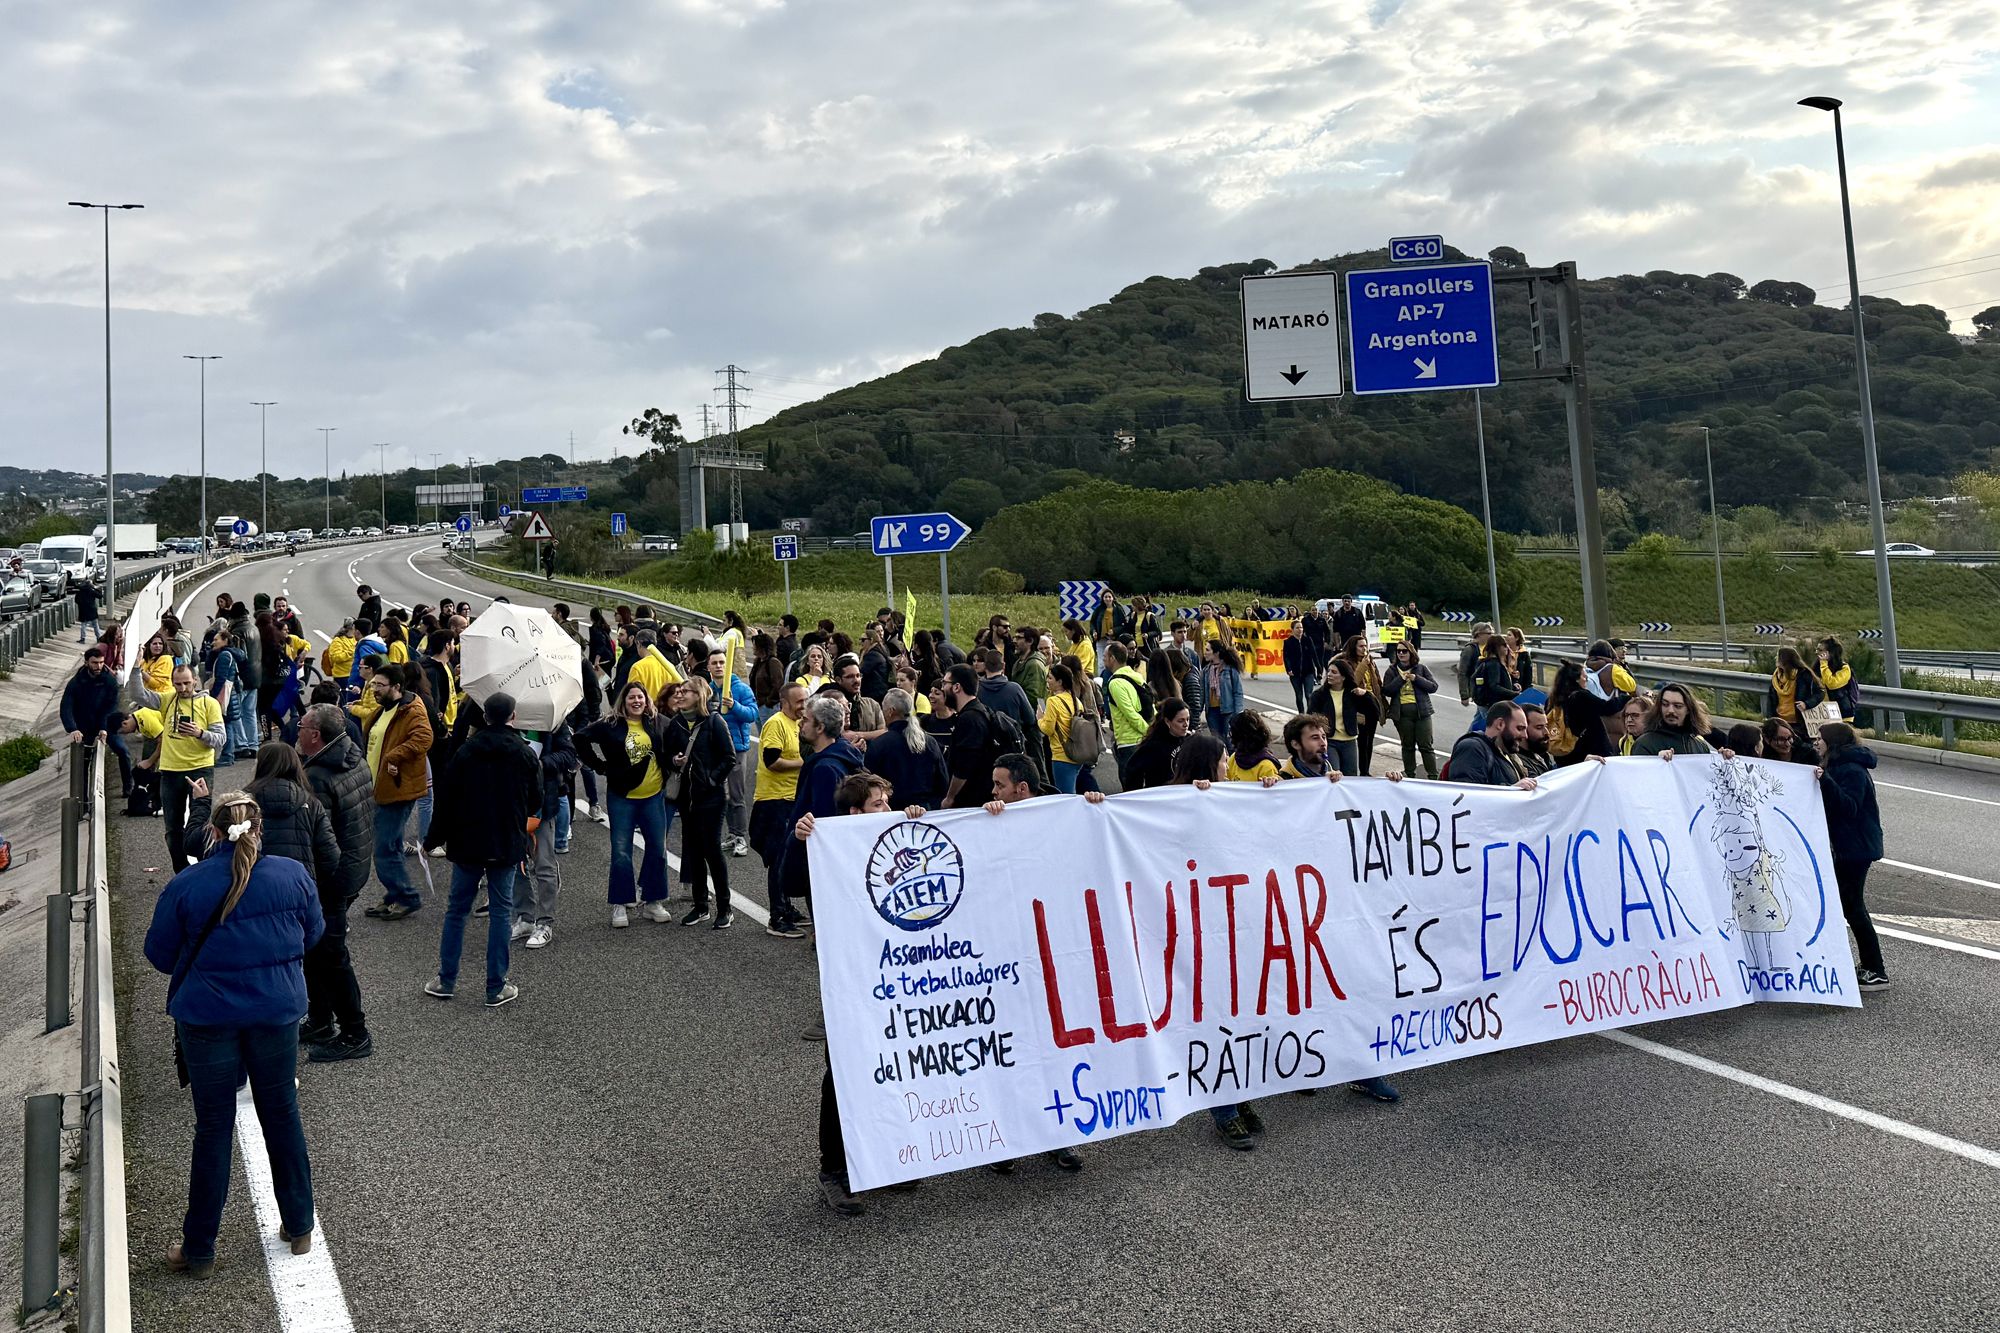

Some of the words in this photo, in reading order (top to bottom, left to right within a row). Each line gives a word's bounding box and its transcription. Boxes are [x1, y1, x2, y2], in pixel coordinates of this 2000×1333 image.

[1395, 241, 1438, 257] C-60
[1364, 278, 1474, 298] Granollers
[1252, 310, 1330, 330] MATARÓ
[1397, 303, 1445, 321] AP-7
[1368, 329, 1477, 350] Argentona
[919, 523, 951, 542] 99
[780, 550, 791, 558] 99
[1256, 648, 1284, 666] EDU
[1335, 793, 1472, 883] TAMBÉ
[892, 875, 949, 912] ATEM
[1388, 904, 1443, 999] ÉS
[1480, 828, 1702, 982] EDUCAR
[880, 933, 984, 969] Assemblea
[873, 974, 896, 1000] de
[898, 961, 1020, 997] treballadores
[1737, 952, 1843, 995] DMOCRÀCIA
[884, 986, 996, 1039] d'EDUCACIÓ
[874, 1052, 903, 1084] del
[908, 1031, 1016, 1080] MARESME
[904, 1087, 980, 1123] Docents
[899, 1144, 921, 1165] en
